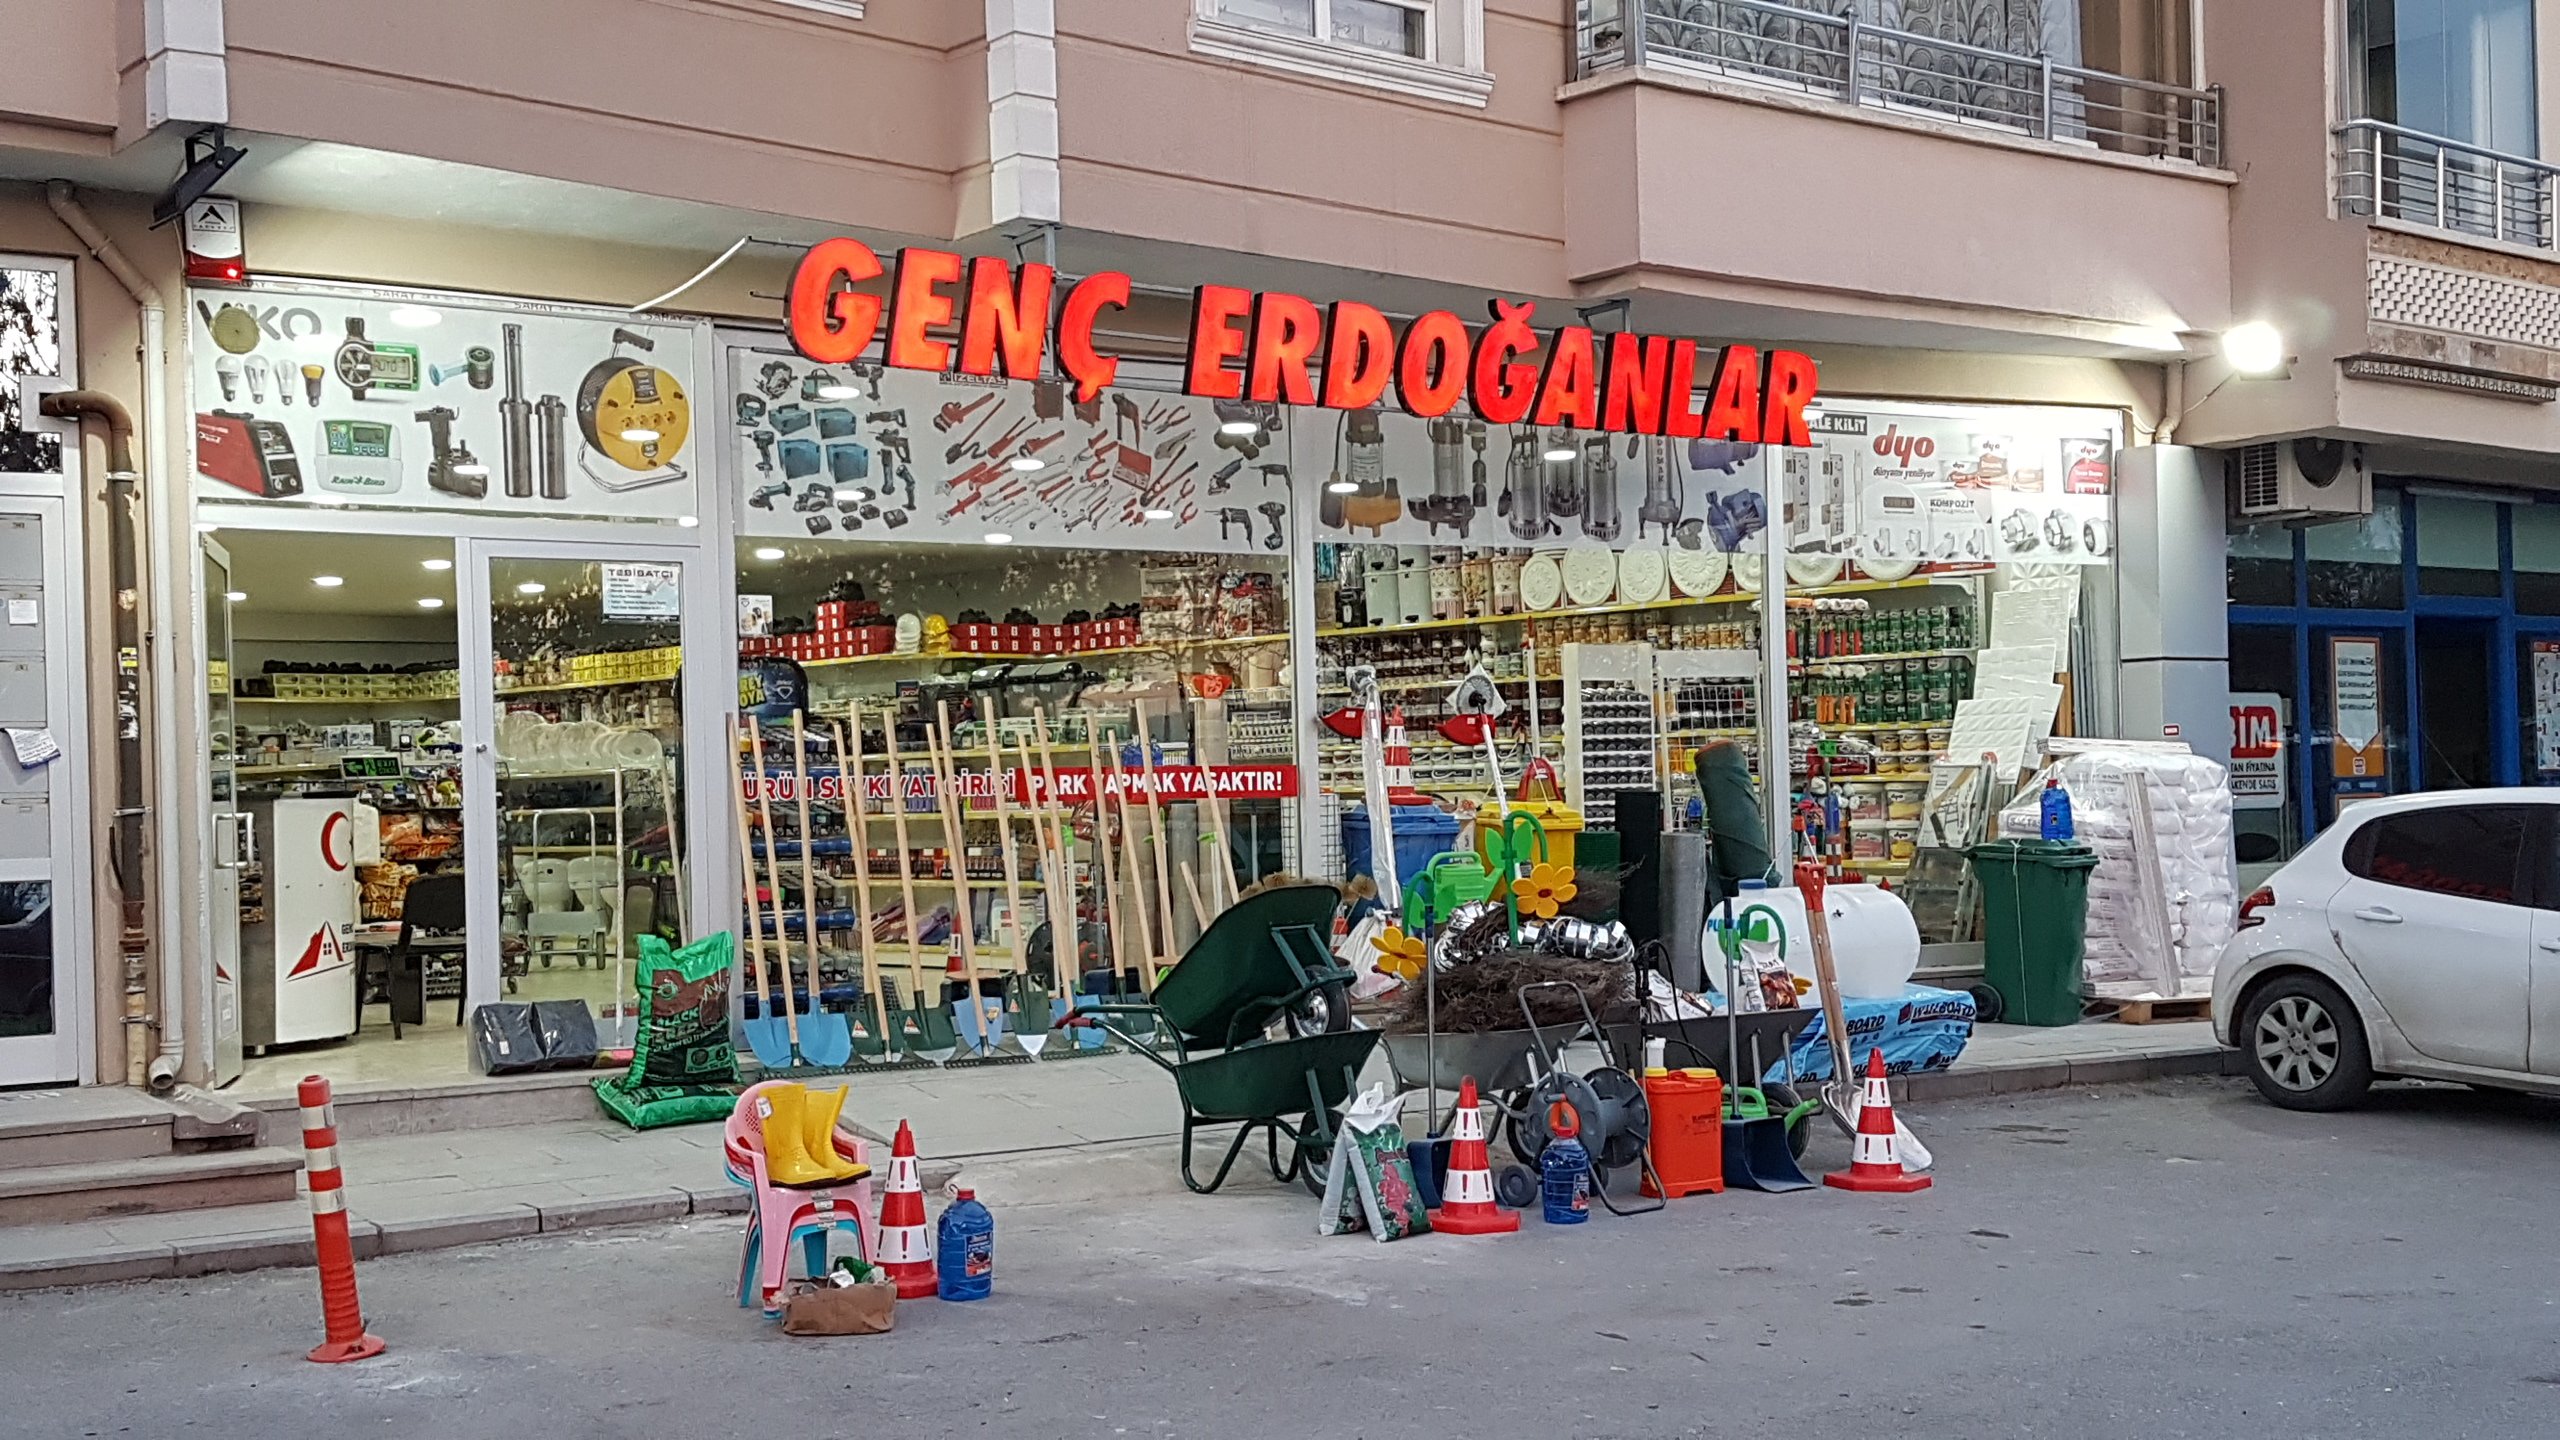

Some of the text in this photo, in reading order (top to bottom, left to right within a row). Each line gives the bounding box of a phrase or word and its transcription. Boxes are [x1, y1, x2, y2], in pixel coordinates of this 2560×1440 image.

[786, 237, 1818, 447] GENÇ ERDOĞANLAR
[1808, 416, 1832, 430] ALE
[1873, 424, 1935, 468] dyo
[1982, 440, 2001, 452] dyo
[2080, 445, 2097, 456] dyo
[1180, 771, 1282, 793] YASAKTIR!
